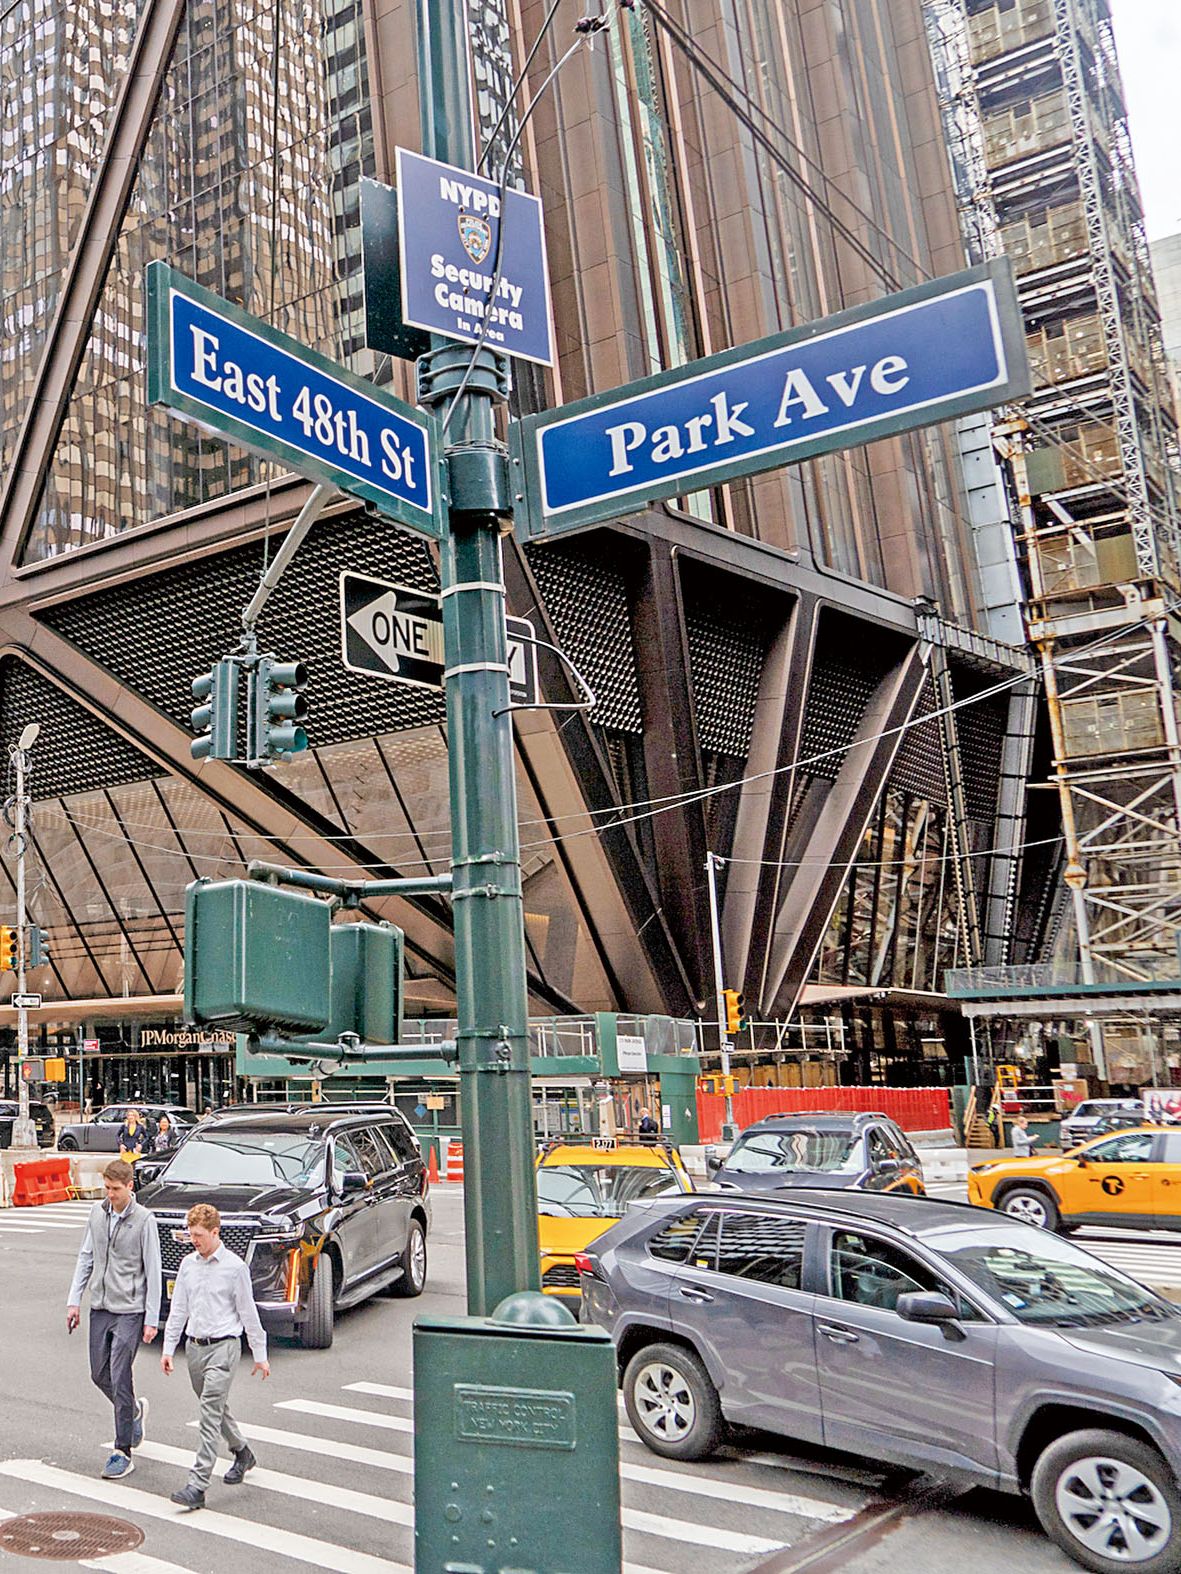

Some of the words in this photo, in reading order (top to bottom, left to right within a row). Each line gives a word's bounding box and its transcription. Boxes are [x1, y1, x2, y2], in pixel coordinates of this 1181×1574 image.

[440, 177, 500, 218] NYPD
[434, 283, 524, 331] Camera
[457, 317, 471, 332] In
[189, 323, 283, 422] East
[292, 386, 372, 467] 48th
[380, 428, 417, 489] St
[605, 391, 755, 477] Park
[773, 354, 910, 429] Ave
[372, 611, 430, 656] ONE
[463, 1400, 509, 1415] TRAFFIC
[514, 1404, 566, 1420] CONTROL
[471, 1417, 495, 1429] NEW
[499, 1419, 528, 1433] YORK
[532, 1422, 559, 1434] CITY
